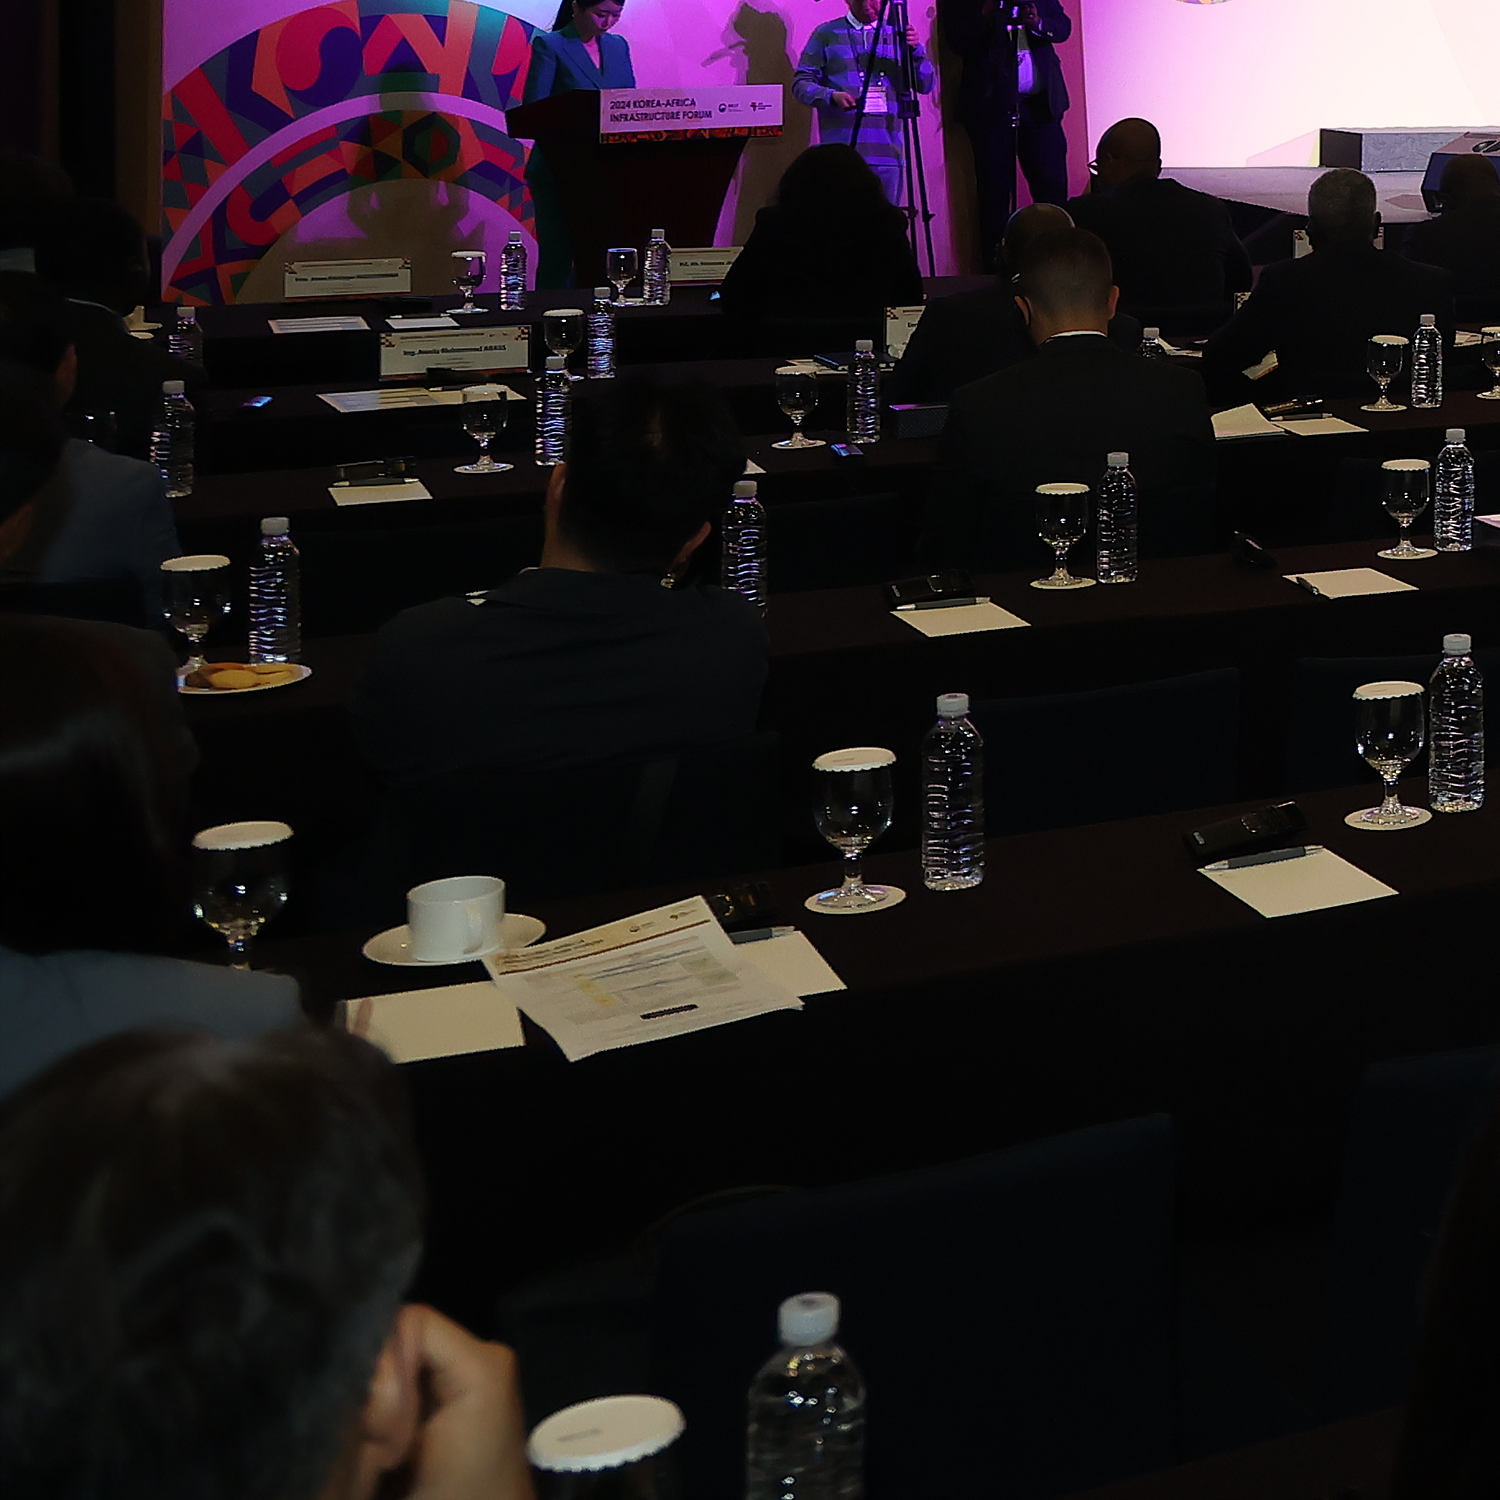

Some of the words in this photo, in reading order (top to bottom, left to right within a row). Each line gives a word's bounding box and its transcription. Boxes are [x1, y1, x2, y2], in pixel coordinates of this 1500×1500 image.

[610, 100, 631, 109] 2024
[633, 98, 696, 109] KOREA-AFRICA
[610, 112, 680, 122] INFRASTRUCTURE
[682, 110, 712, 120] FORUM
